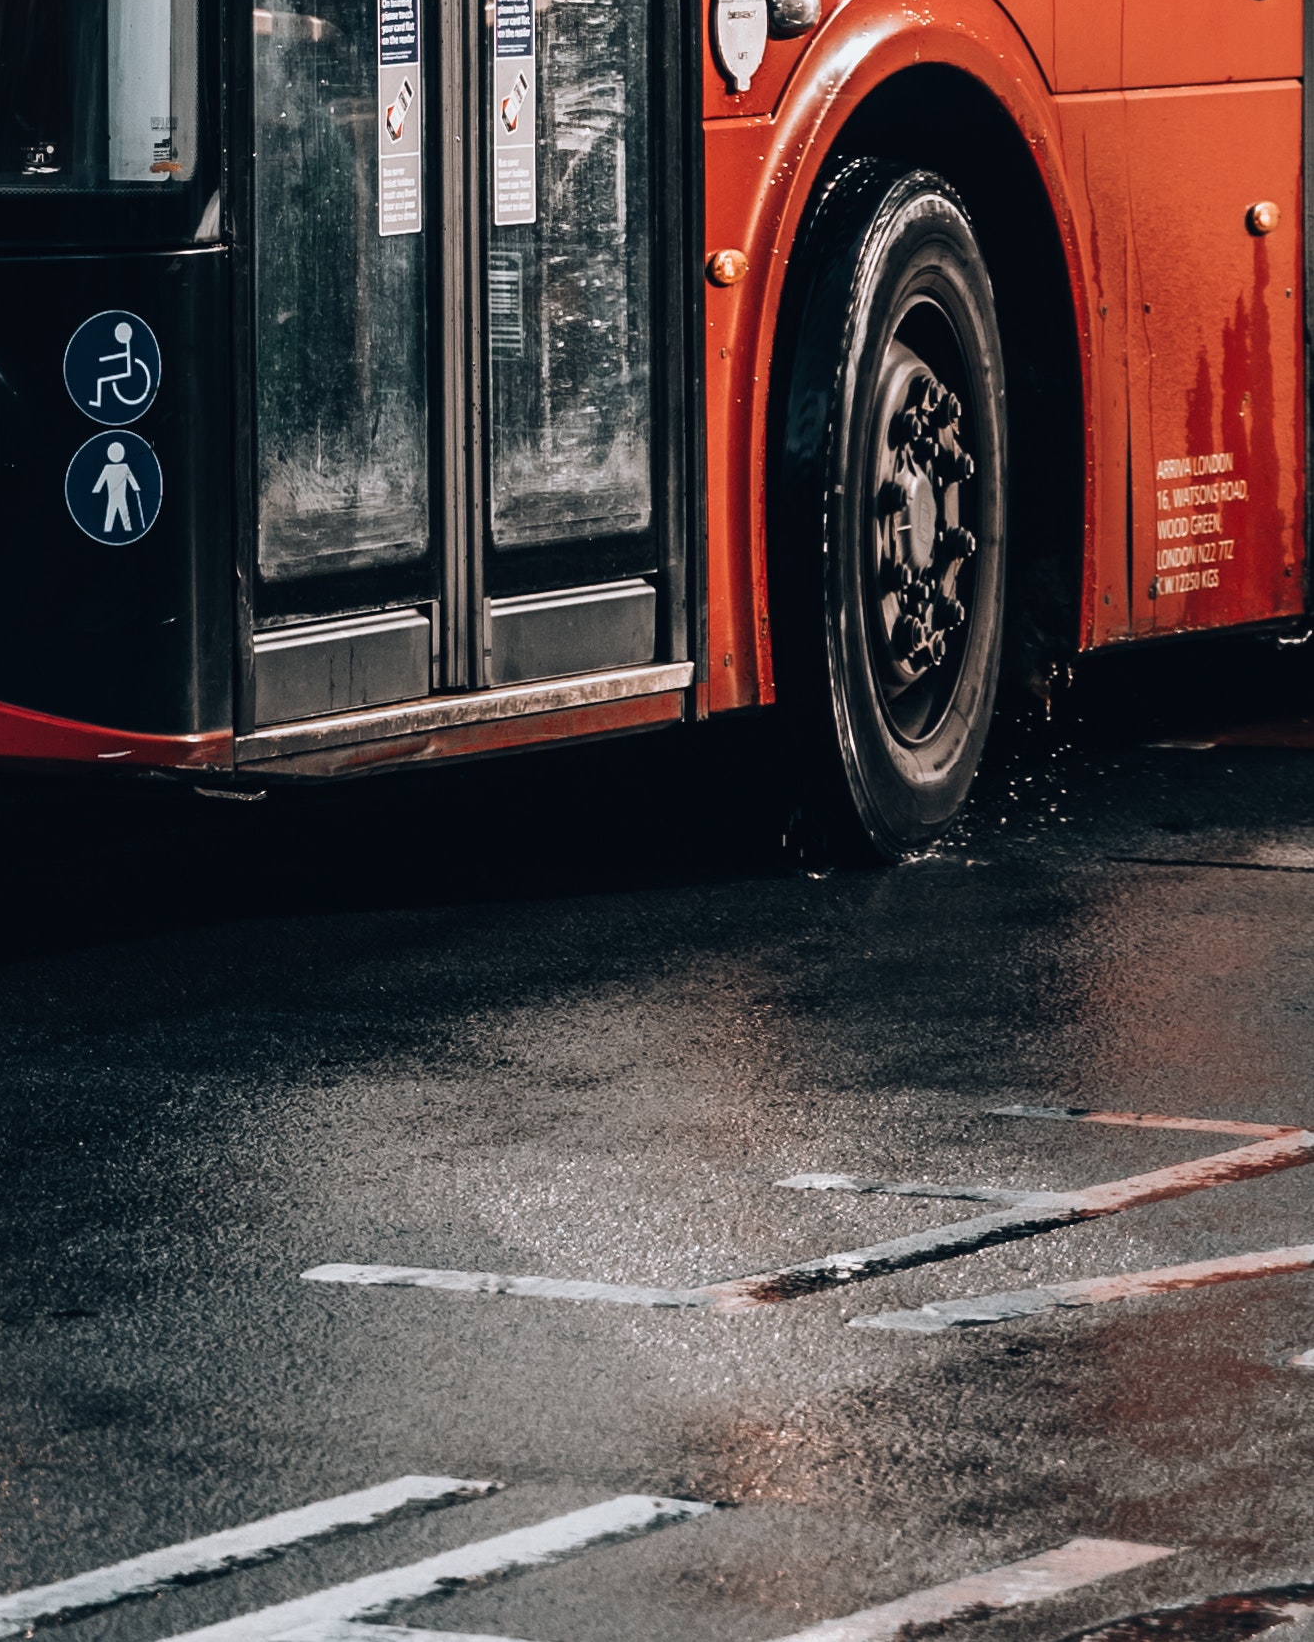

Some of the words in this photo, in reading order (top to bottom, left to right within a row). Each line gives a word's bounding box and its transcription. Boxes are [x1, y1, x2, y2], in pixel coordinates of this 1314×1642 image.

[1157, 458, 1191, 480] ARRIVA
[1193, 453, 1234, 476] LONDON
[1157, 490, 1171, 511] 16,
[1173, 483, 1219, 508] WATSONS
[1221, 480, 1249, 502] ROAD,
[1157, 517, 1189, 540] WOOD
[1191, 513, 1222, 535] GREEN,
[1157, 546, 1196, 570] LONDON
[1198, 543, 1216, 564] N22
[1218, 540, 1234, 560] 7TZ
[1201, 569, 1219, 588] KGS
